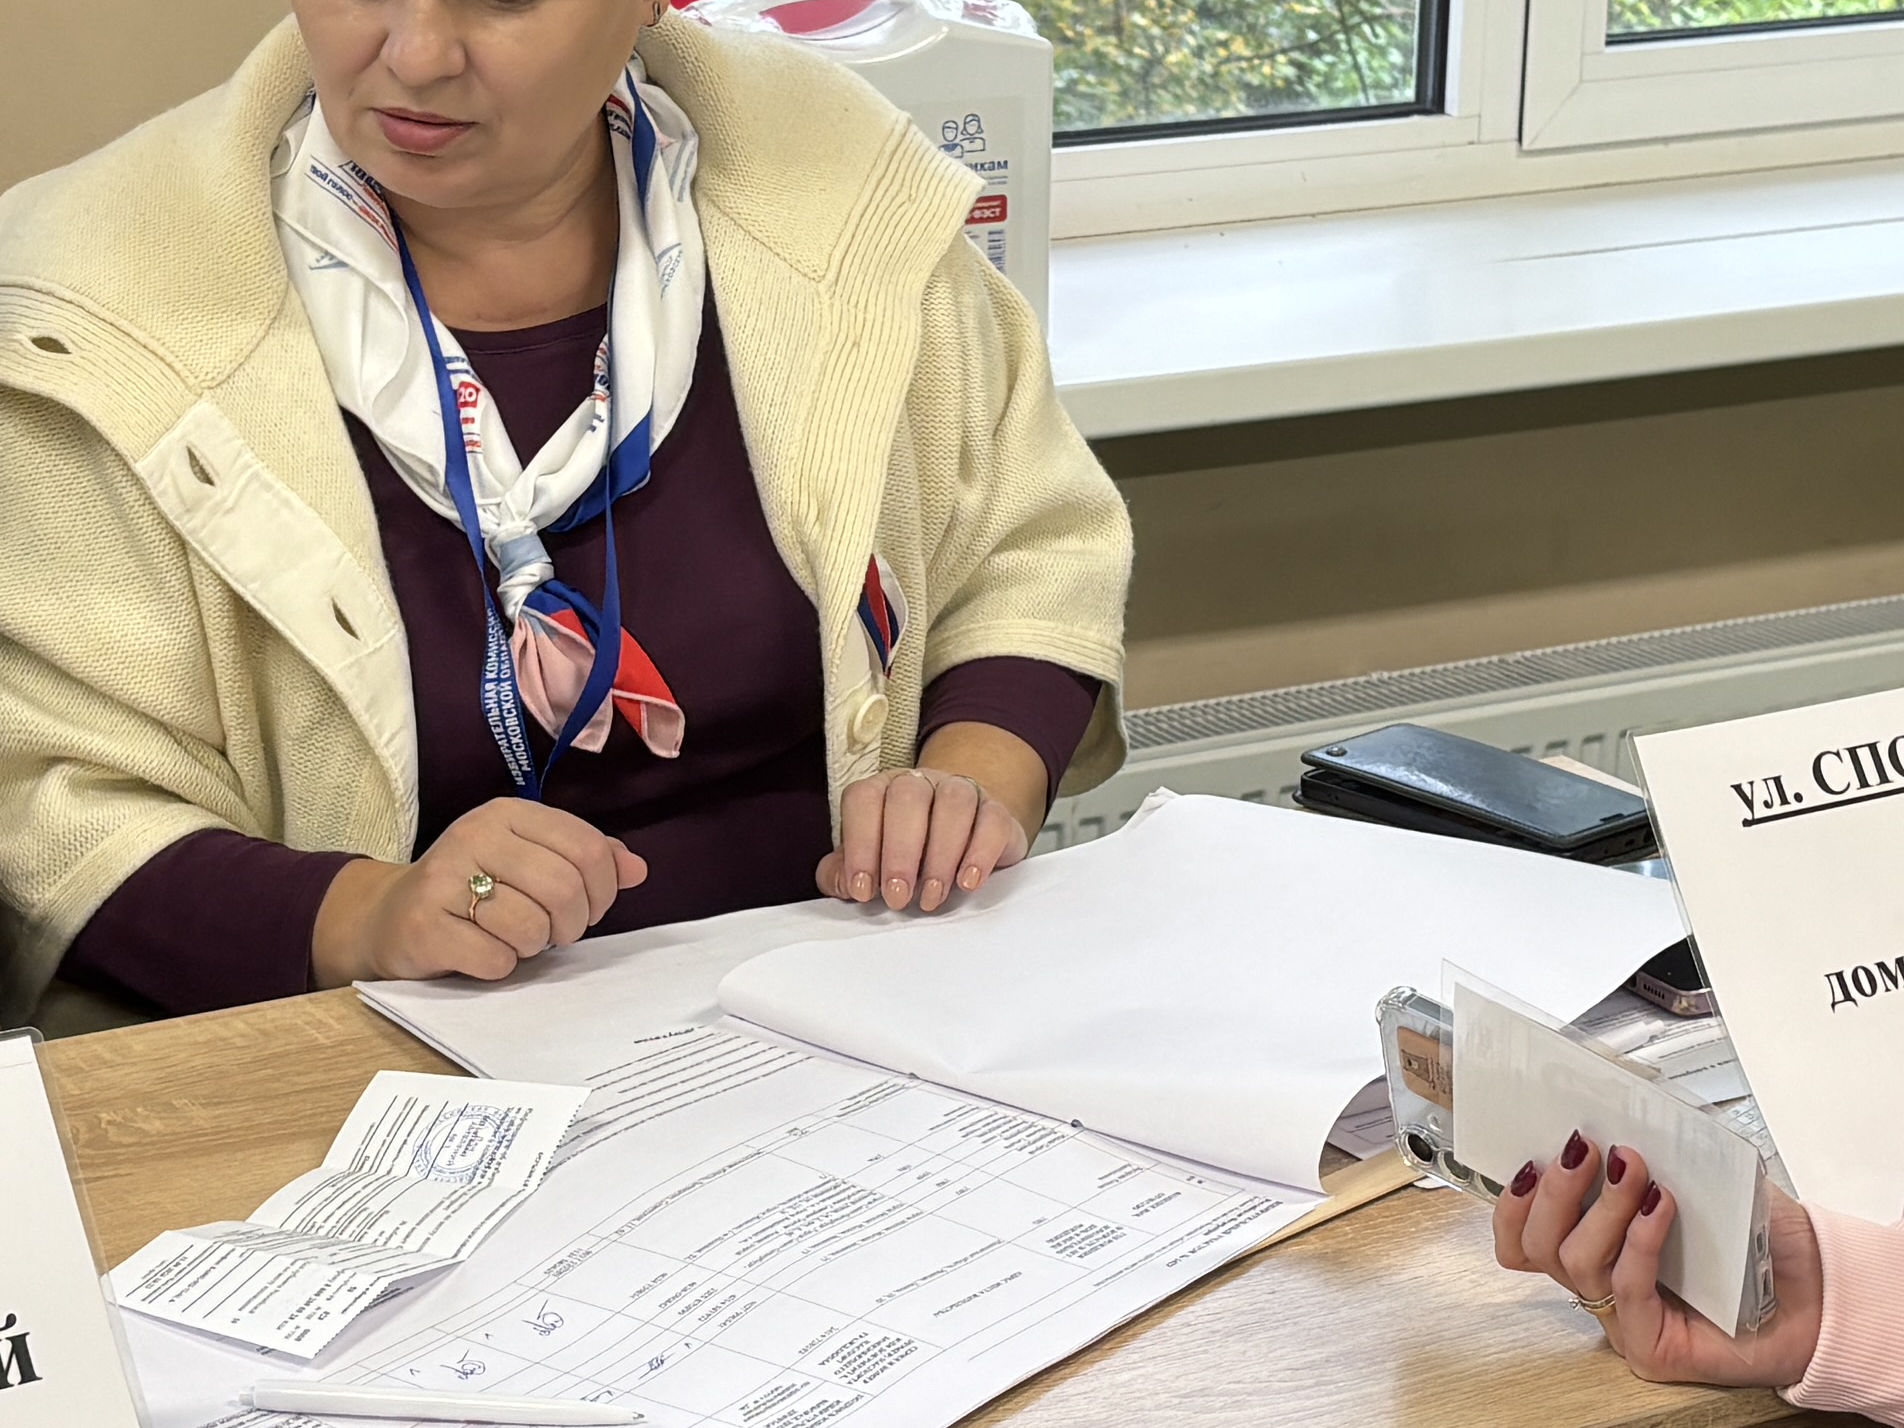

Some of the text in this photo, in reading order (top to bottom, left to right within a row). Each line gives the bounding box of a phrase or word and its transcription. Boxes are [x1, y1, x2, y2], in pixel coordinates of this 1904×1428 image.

[483, 681, 525, 786] ИЗБИРАТЕЛЬНАЯ
[496, 680, 531, 771] МОСКОВСКОЙ
[1730, 775, 1804, 821] ул.
